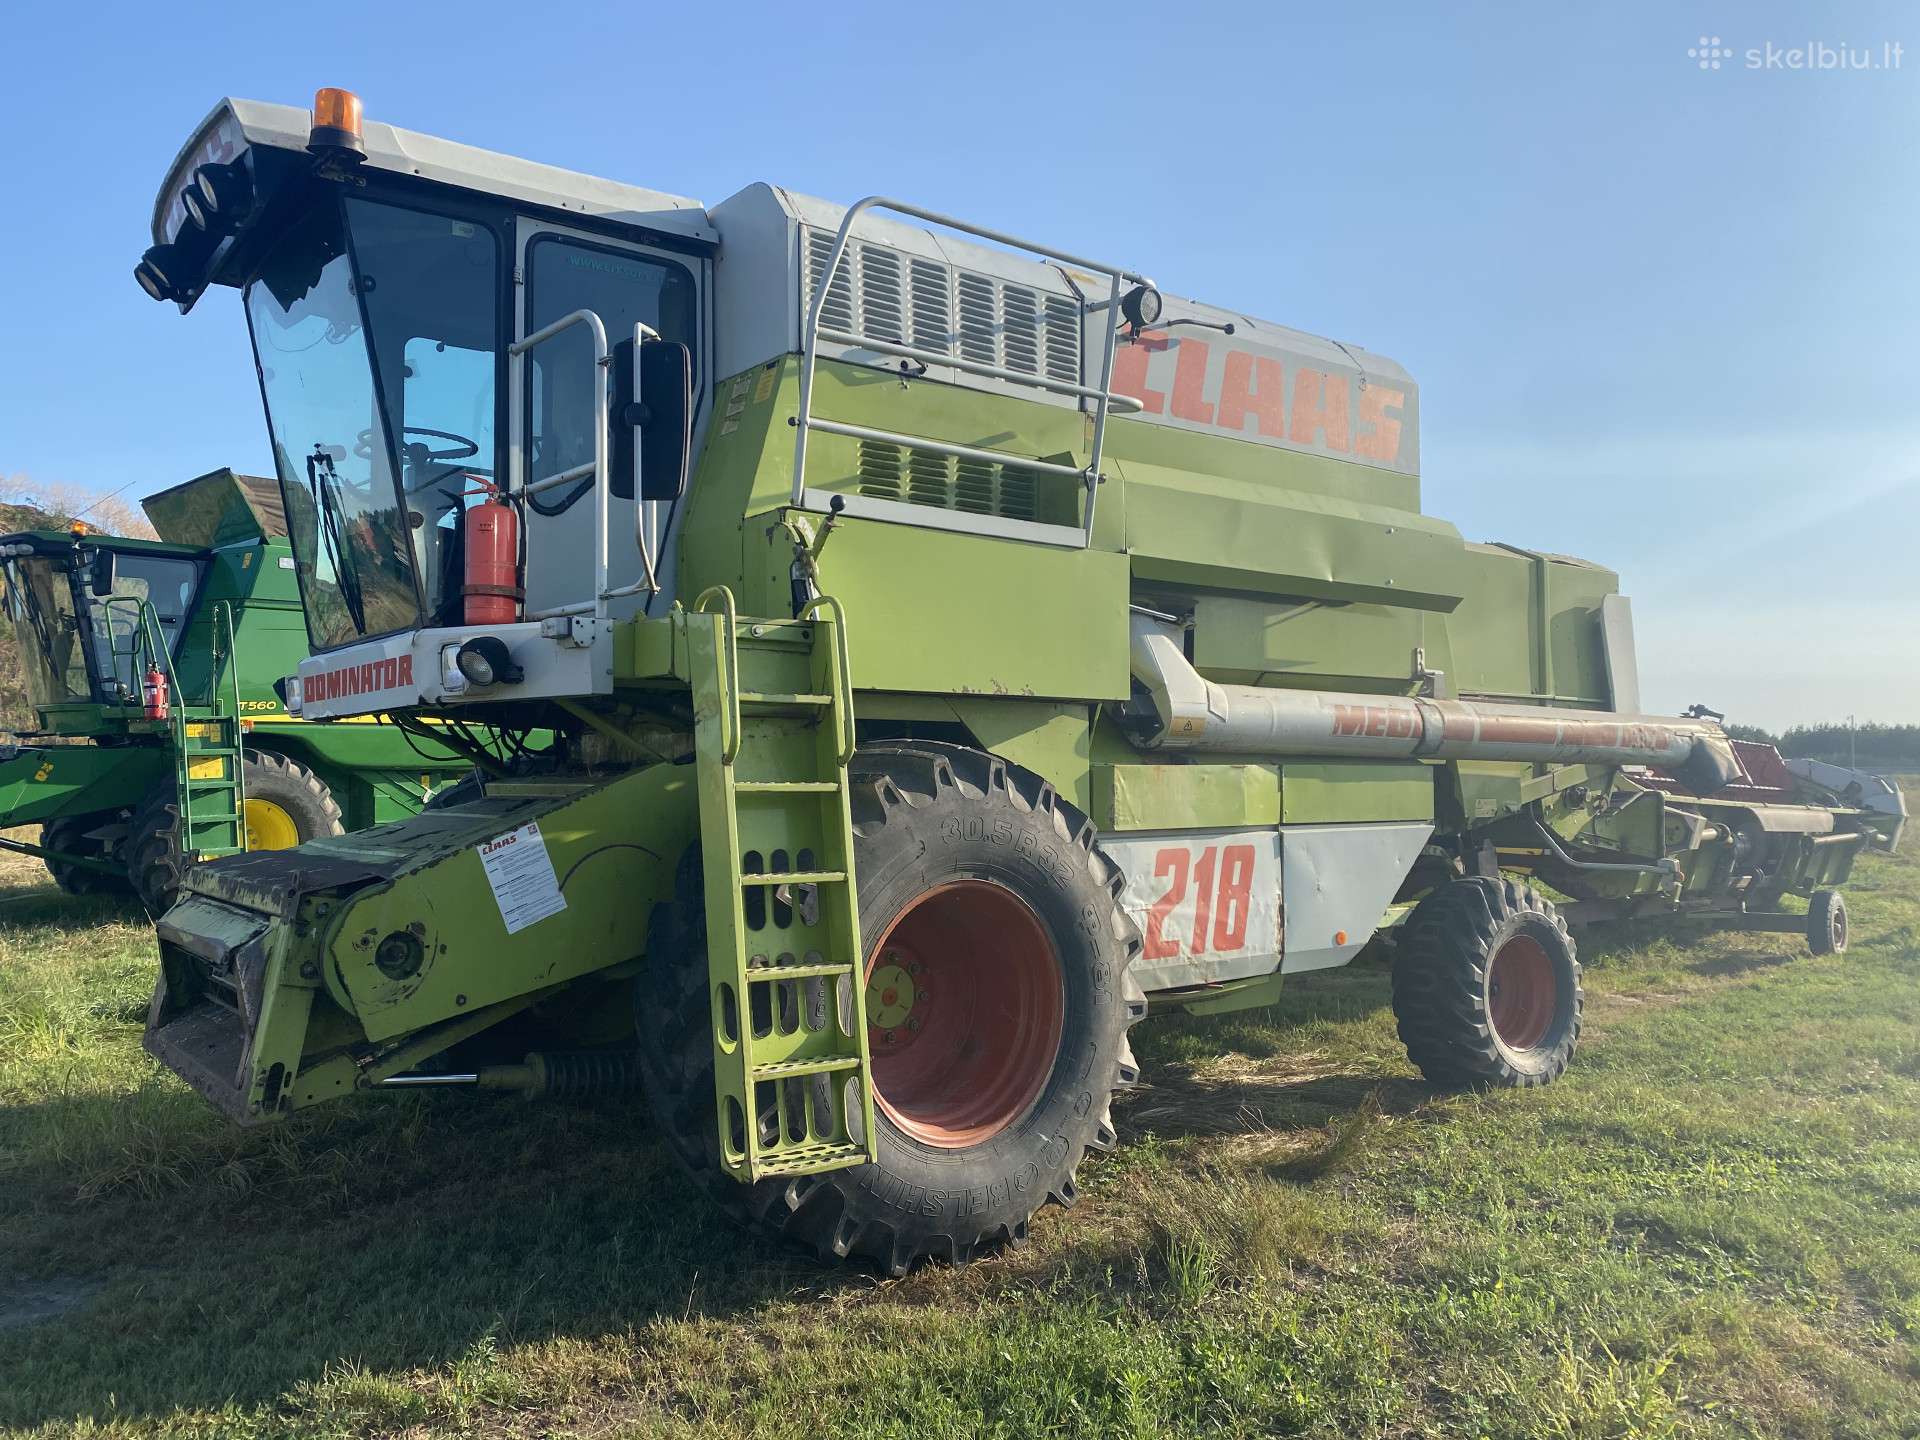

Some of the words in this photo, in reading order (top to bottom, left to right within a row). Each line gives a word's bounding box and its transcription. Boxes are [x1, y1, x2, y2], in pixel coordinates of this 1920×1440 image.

[1107, 321, 1405, 462] CLAAS
[304, 654, 414, 704] DOMINATOR
[482, 834, 517, 856] CLAAS
[1142, 844, 1256, 961] 218
[845, 1162, 1011, 1218] BELSHIN
